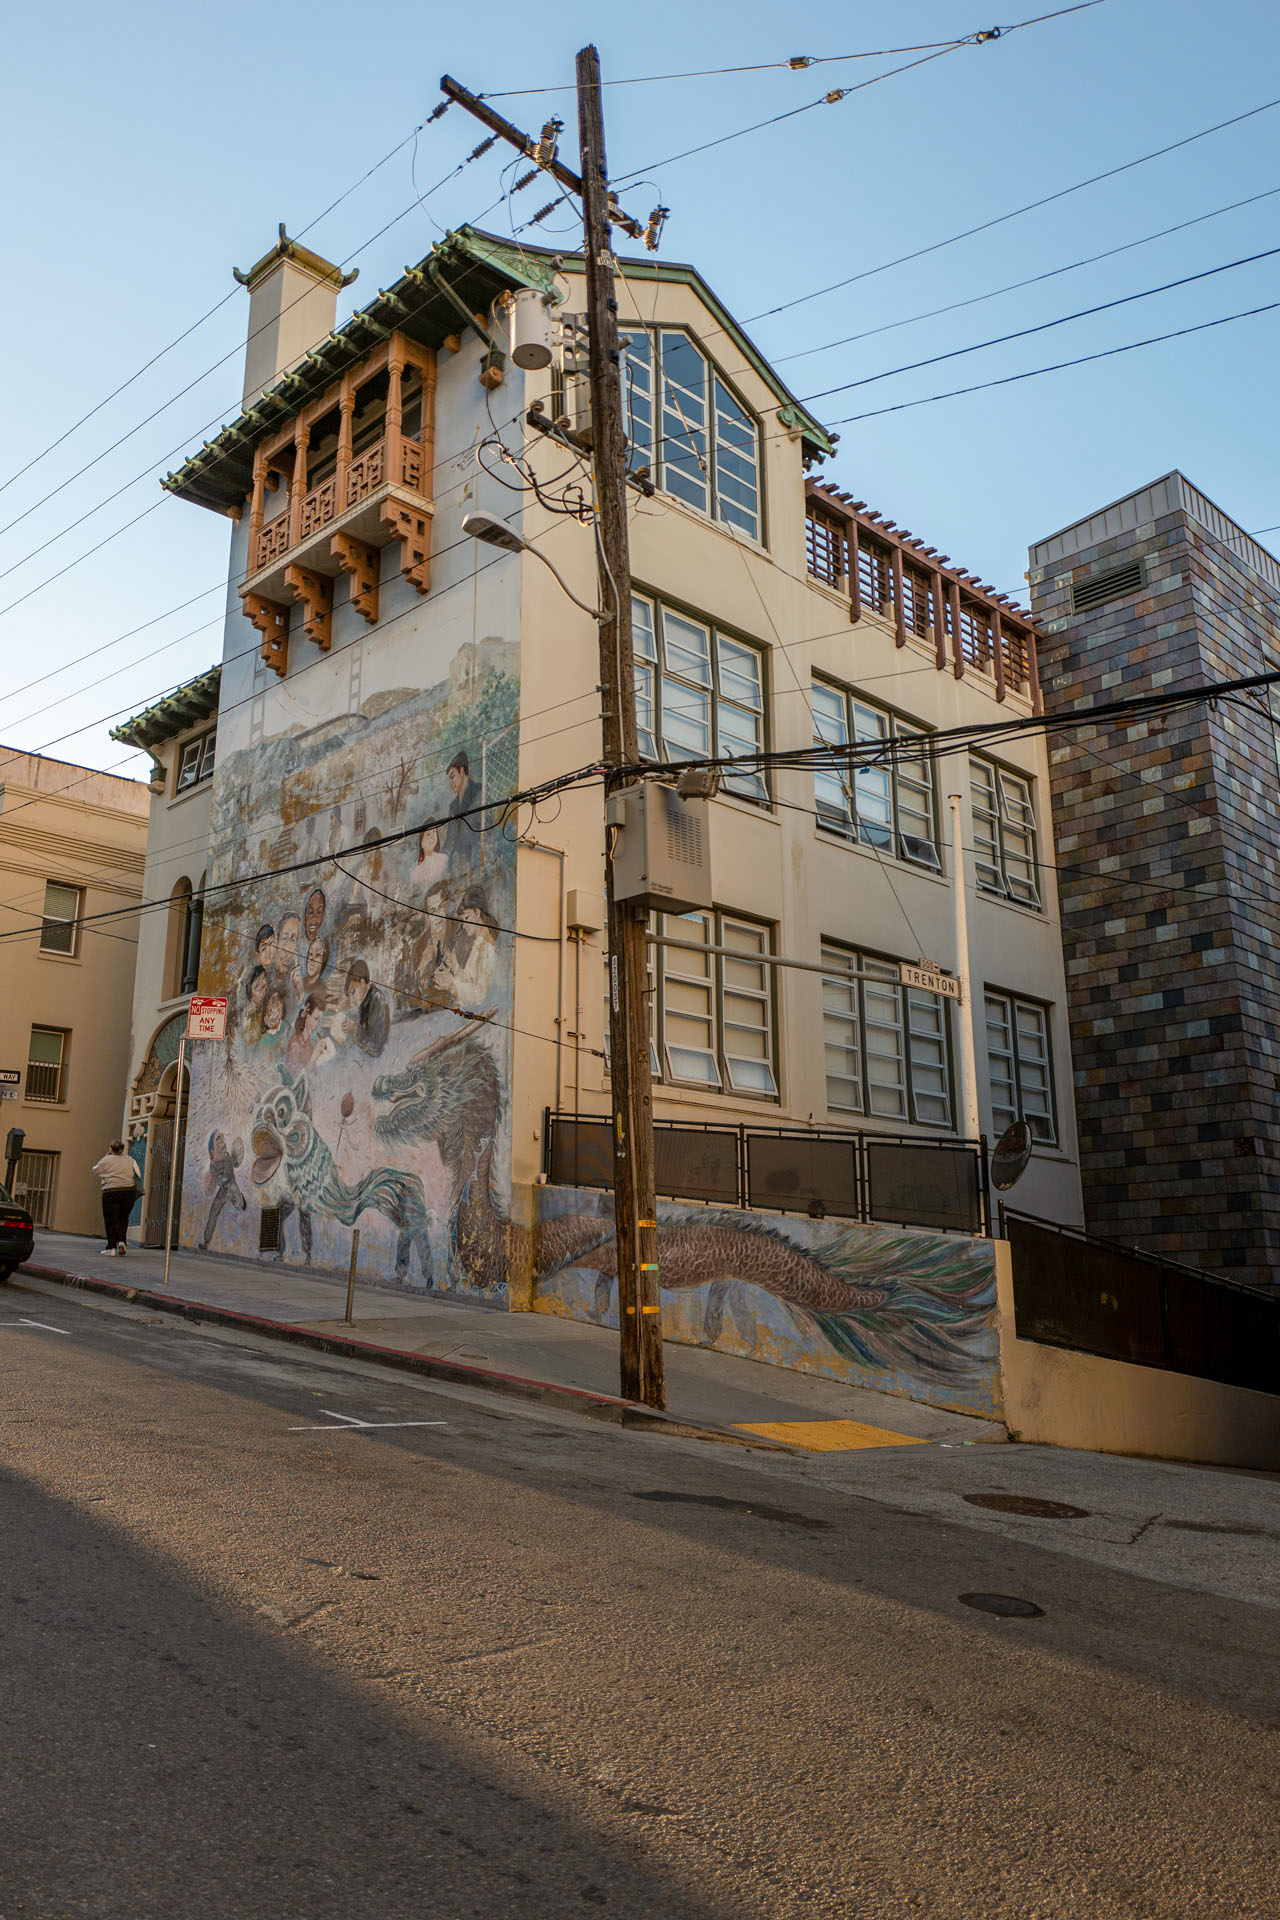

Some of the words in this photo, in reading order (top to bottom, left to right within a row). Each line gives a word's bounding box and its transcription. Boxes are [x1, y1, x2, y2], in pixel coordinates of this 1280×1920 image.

[906, 969, 955, 993] TRENTON
[191, 1005, 200, 1014] NO
[201, 1007, 225, 1015] STOPPING
